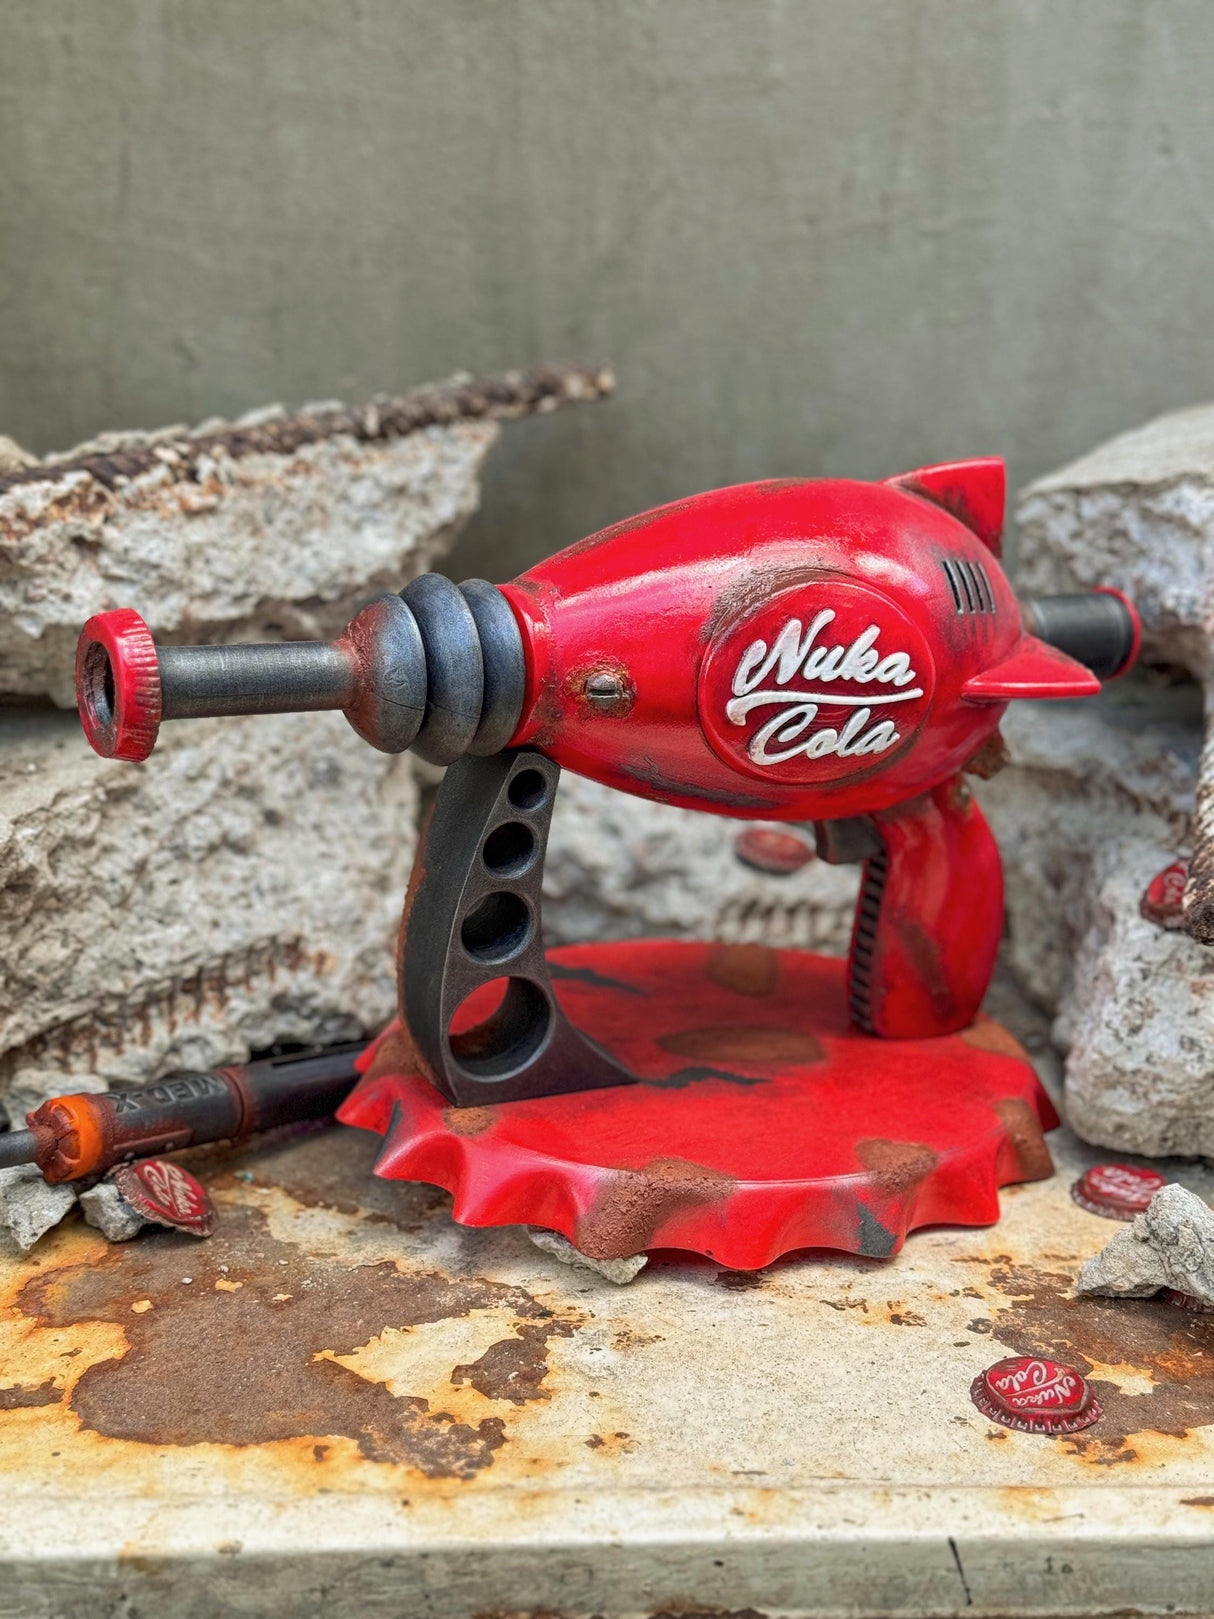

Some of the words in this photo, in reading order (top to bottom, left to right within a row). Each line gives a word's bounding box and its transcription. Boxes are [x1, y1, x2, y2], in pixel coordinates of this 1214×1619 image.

[732, 608, 916, 697] Nuka
[749, 703, 900, 766] Cola
[995, 1361, 1047, 1391] Cola
[1012, 1376, 1076, 1406] Nuka
